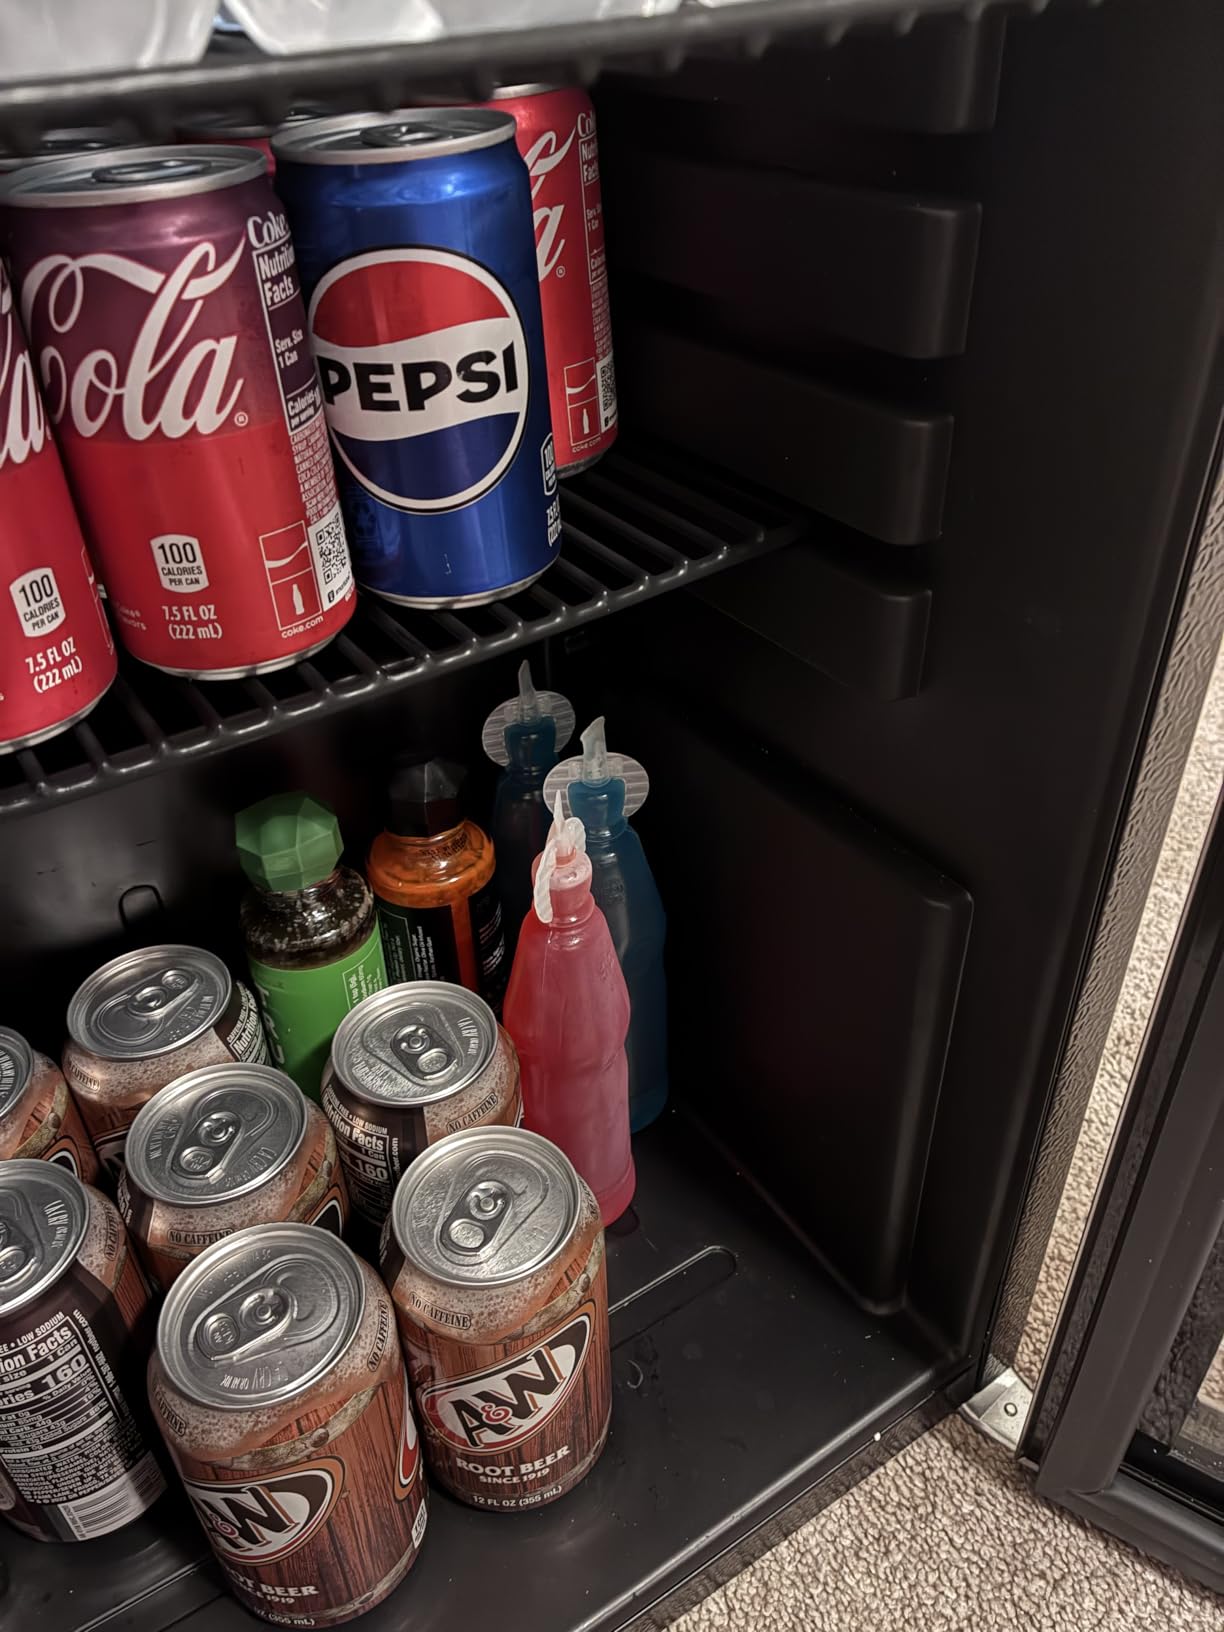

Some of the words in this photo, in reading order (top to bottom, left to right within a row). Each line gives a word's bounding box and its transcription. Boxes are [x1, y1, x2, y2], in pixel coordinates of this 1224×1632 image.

[263, 275, 295, 306] Facts
[316, 339, 519, 412] PEPSI
[157, 542, 197, 565] 100
[161, 565, 203, 577] CALORIES
[168, 579, 184, 587] PER
[185, 577, 200, 586] CAN
[18, 574, 55, 607] 100
[22, 597, 60, 623] CALORIES
[32, 619, 47, 631] PER
[46, 610, 60, 625] CAN
[161, 605, 181, 621] 7.5
[182, 606, 198, 621] FL
[199, 604, 218, 620] OZ
[168, 623, 196, 639] (222
[196, 622, 223, 639] mL)
[281, 615, 324, 639] coke.com
[24, 652, 48, 674] 7.5
[47, 645, 62, 665] FL
[61, 636, 77, 656] OZ
[33, 671, 62, 693] (222
[61, 655, 82, 679] mL)
[232, 1010, 258, 1055] Nutrition
[338, 1102, 350, 1118] FREE
[352, 1113, 366, 1128] LOW
[364, 1122, 388, 1135] SODIUM
[449, 1120, 463, 1134] NO
[462, 1094, 497, 1127] CAFFEINE
[351, 1126, 385, 1152] Facts
[356, 1158, 389, 1180] 160
[170, 1230, 183, 1244] NO
[410, 1296, 422, 1310] NO
[422, 1301, 470, 1329] CAFFEINE
[16, 1331, 35, 1347] LOW
[35, 1311, 65, 1337] SODIUM
[373, 1302, 389, 1355] CAFFEINE
[26, 1326, 73, 1361] Facts
[2, 1369, 28, 1383] size
[56, 1338, 79, 1357] Can
[41, 1353, 87, 1389] 160
[369, 1355, 380, 1371] NO
[51, 1382, 73, 1398] Daily
[448, 1346, 568, 1448] A&W
[455, 1456, 515, 1477] ROOT
[519, 1444, 571, 1475] BEER
[479, 1475, 521, 1484] SINCE
[522, 1467, 551, 1482] 1919
[473, 1495, 486, 1505] 12
[487, 1498, 501, 1507] FL
[502, 1499, 517, 1508] OZ
[260, 1583, 321, 1597] BEER
